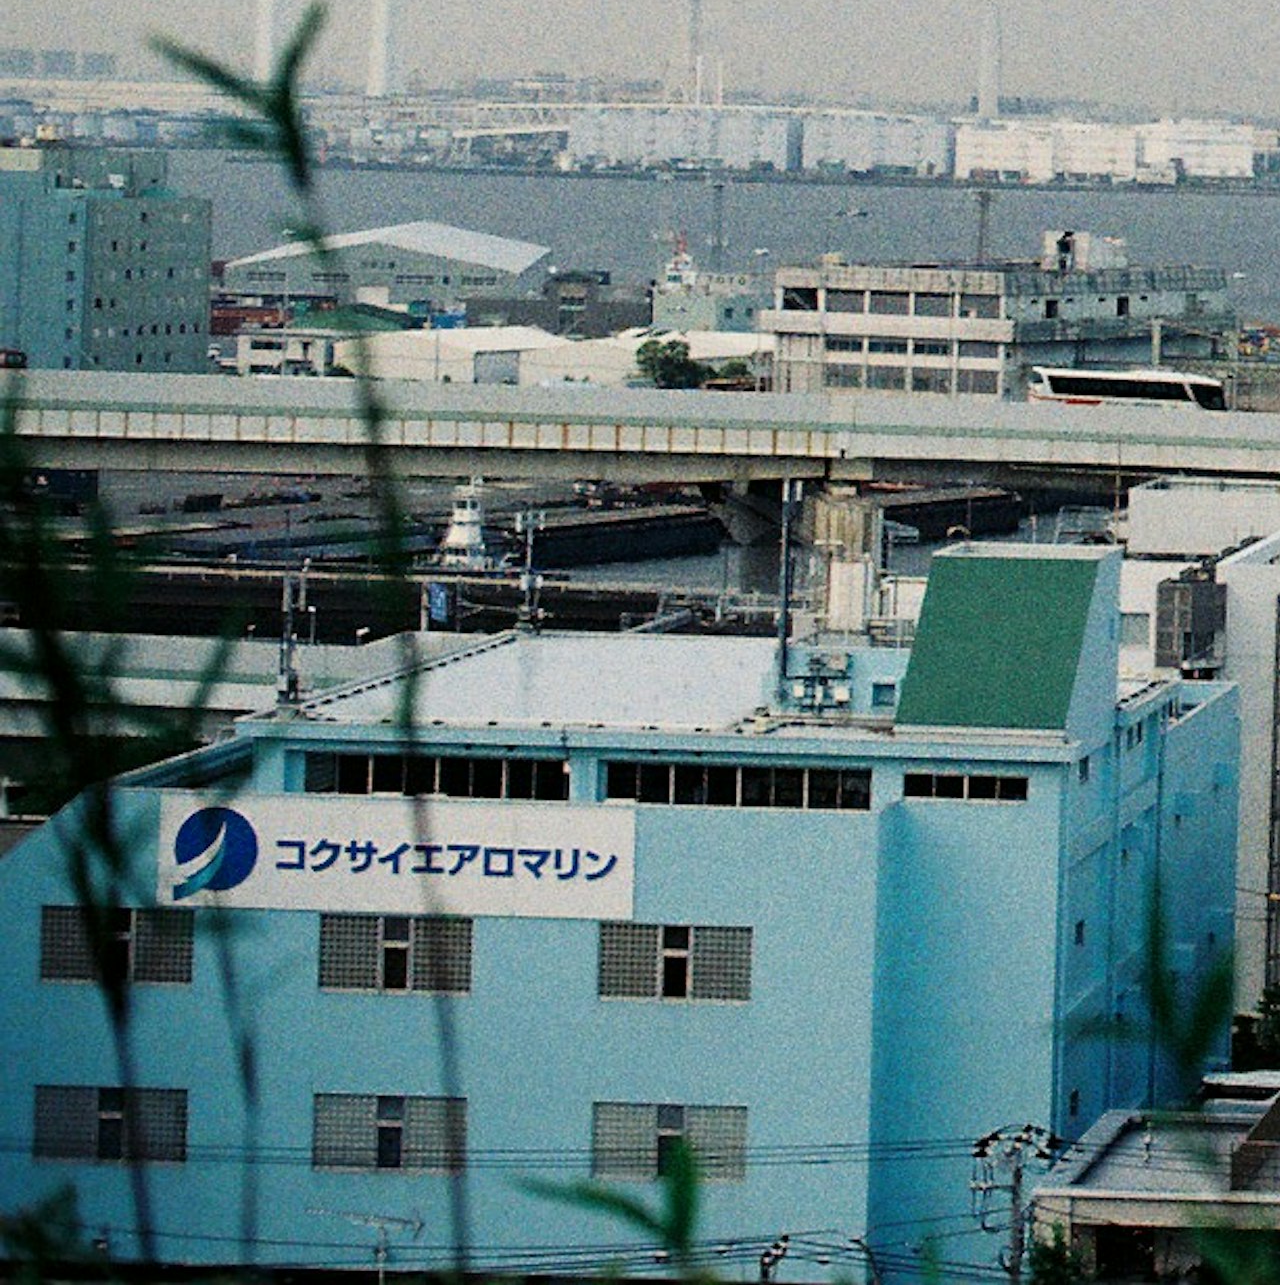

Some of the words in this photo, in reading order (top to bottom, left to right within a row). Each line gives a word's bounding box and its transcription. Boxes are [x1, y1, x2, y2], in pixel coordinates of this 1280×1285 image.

[276, 840, 619, 881] コクサイエアロマリン
